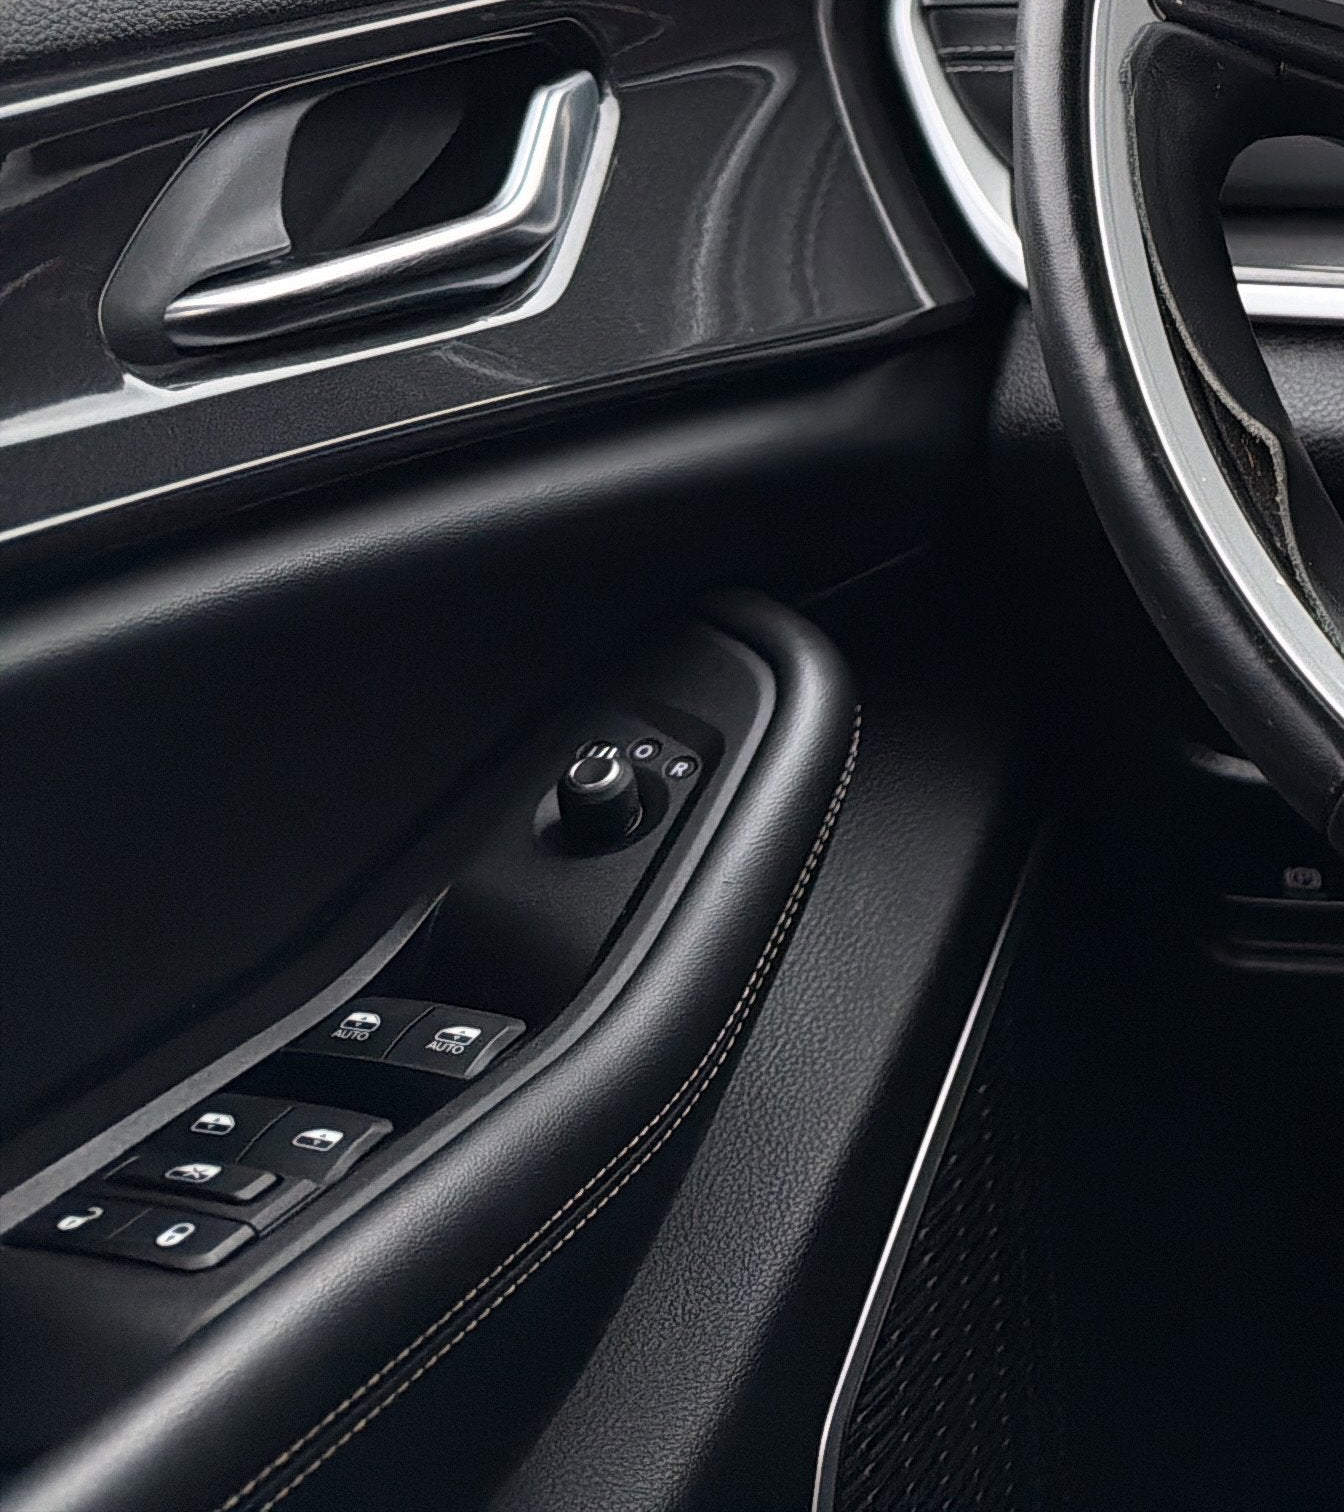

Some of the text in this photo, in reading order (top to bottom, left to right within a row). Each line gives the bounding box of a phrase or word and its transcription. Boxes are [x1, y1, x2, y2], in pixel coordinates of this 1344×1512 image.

[669, 761, 690, 777] R
[331, 1029, 371, 1042] AUTO
[425, 1040, 465, 1056] AUTO
